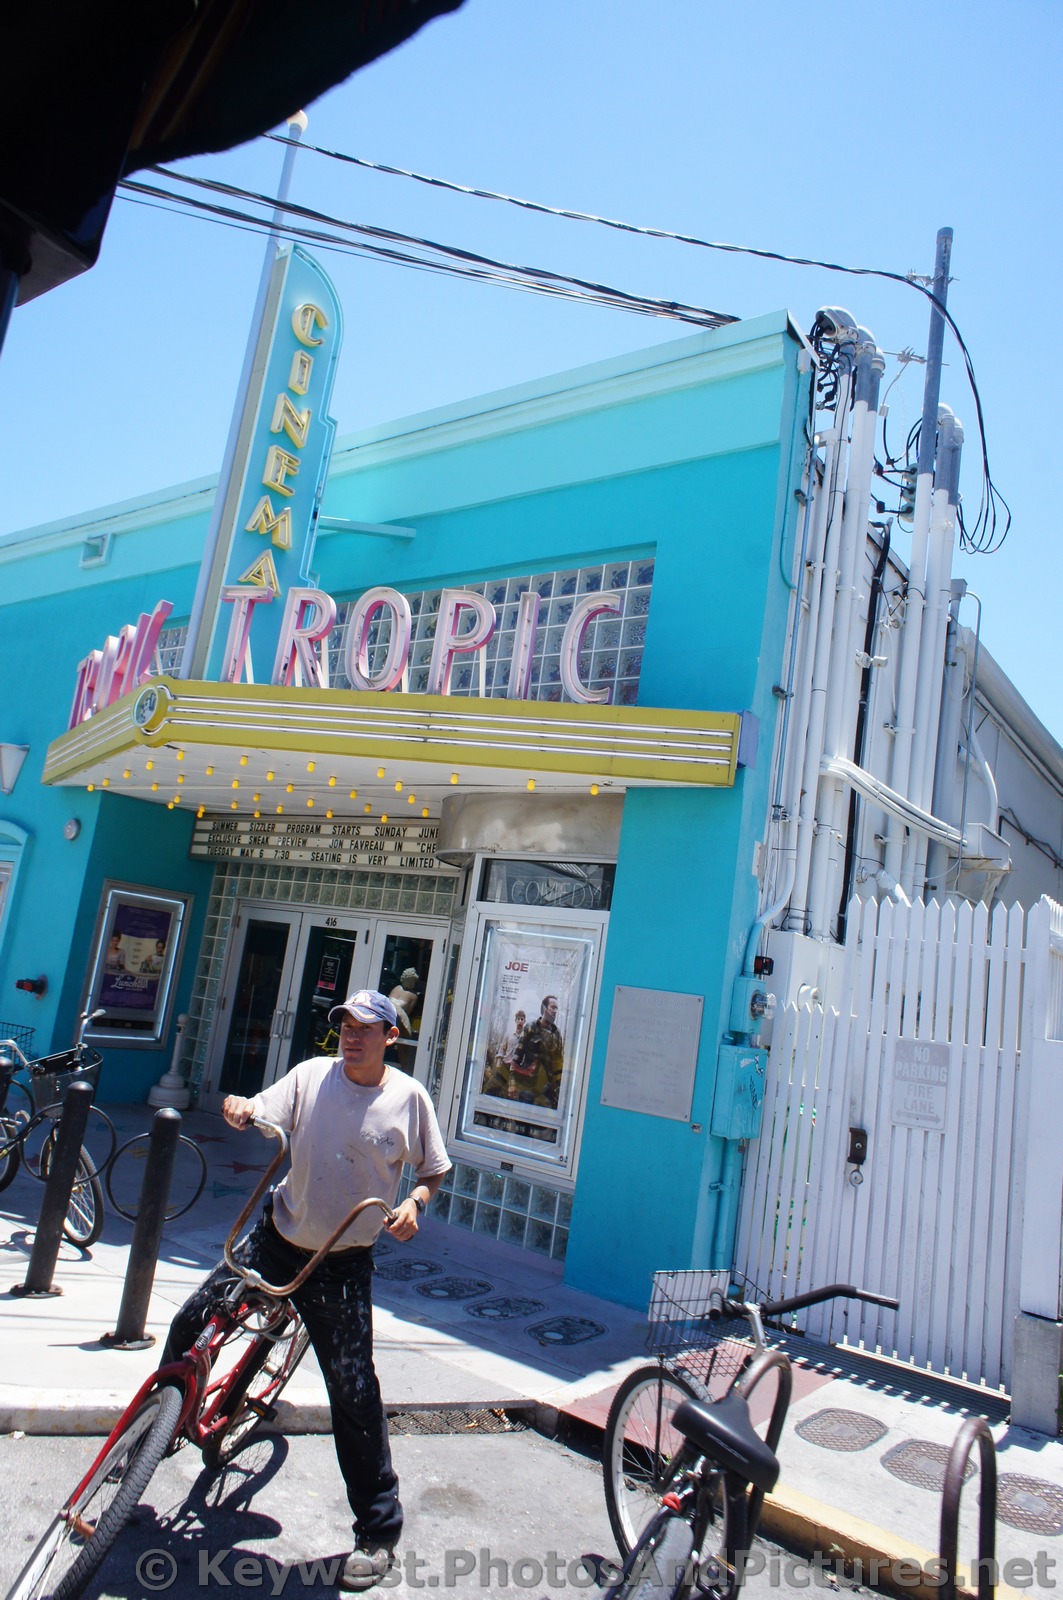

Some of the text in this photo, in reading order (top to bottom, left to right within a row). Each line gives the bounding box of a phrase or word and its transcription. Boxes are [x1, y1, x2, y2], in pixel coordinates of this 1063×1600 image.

[238, 302, 328, 597] CINEMA
[222, 585, 622, 705] TROPIC
[212, 821, 238, 832] SUMMER
[249, 822, 276, 833] SIZZLER
[286, 823, 321, 834] PROGRAM
[332, 825, 361, 836] STARTS
[374, 826, 408, 837] SUNDAY
[208, 833, 242, 845] EXCLUSIVE
[248, 835, 269, 846] SNEAK
[278, 836, 307, 847] PREVIEW
[328, 839, 344, 849] JON
[349, 839, 385, 851] FAVREAU
[394, 842, 403, 852] IN
[207, 846, 234, 857] TUESDAY
[240, 848, 255, 858] MAY
[258, 849, 264, 859] 6
[274, 850, 290, 860] 7:30
[310, 852, 342, 863] SEATING
[348, 854, 358, 864] IS
[368, 855, 389, 866] VERY
[325, 917, 338, 927] 416
[505, 961, 529, 973] JOE
[913, 1046, 930, 1063] NO
[895, 1061, 948, 1083] PARKING
[907, 1083, 933, 1099] FIRE
[903, 1097, 935, 1114] LANE
